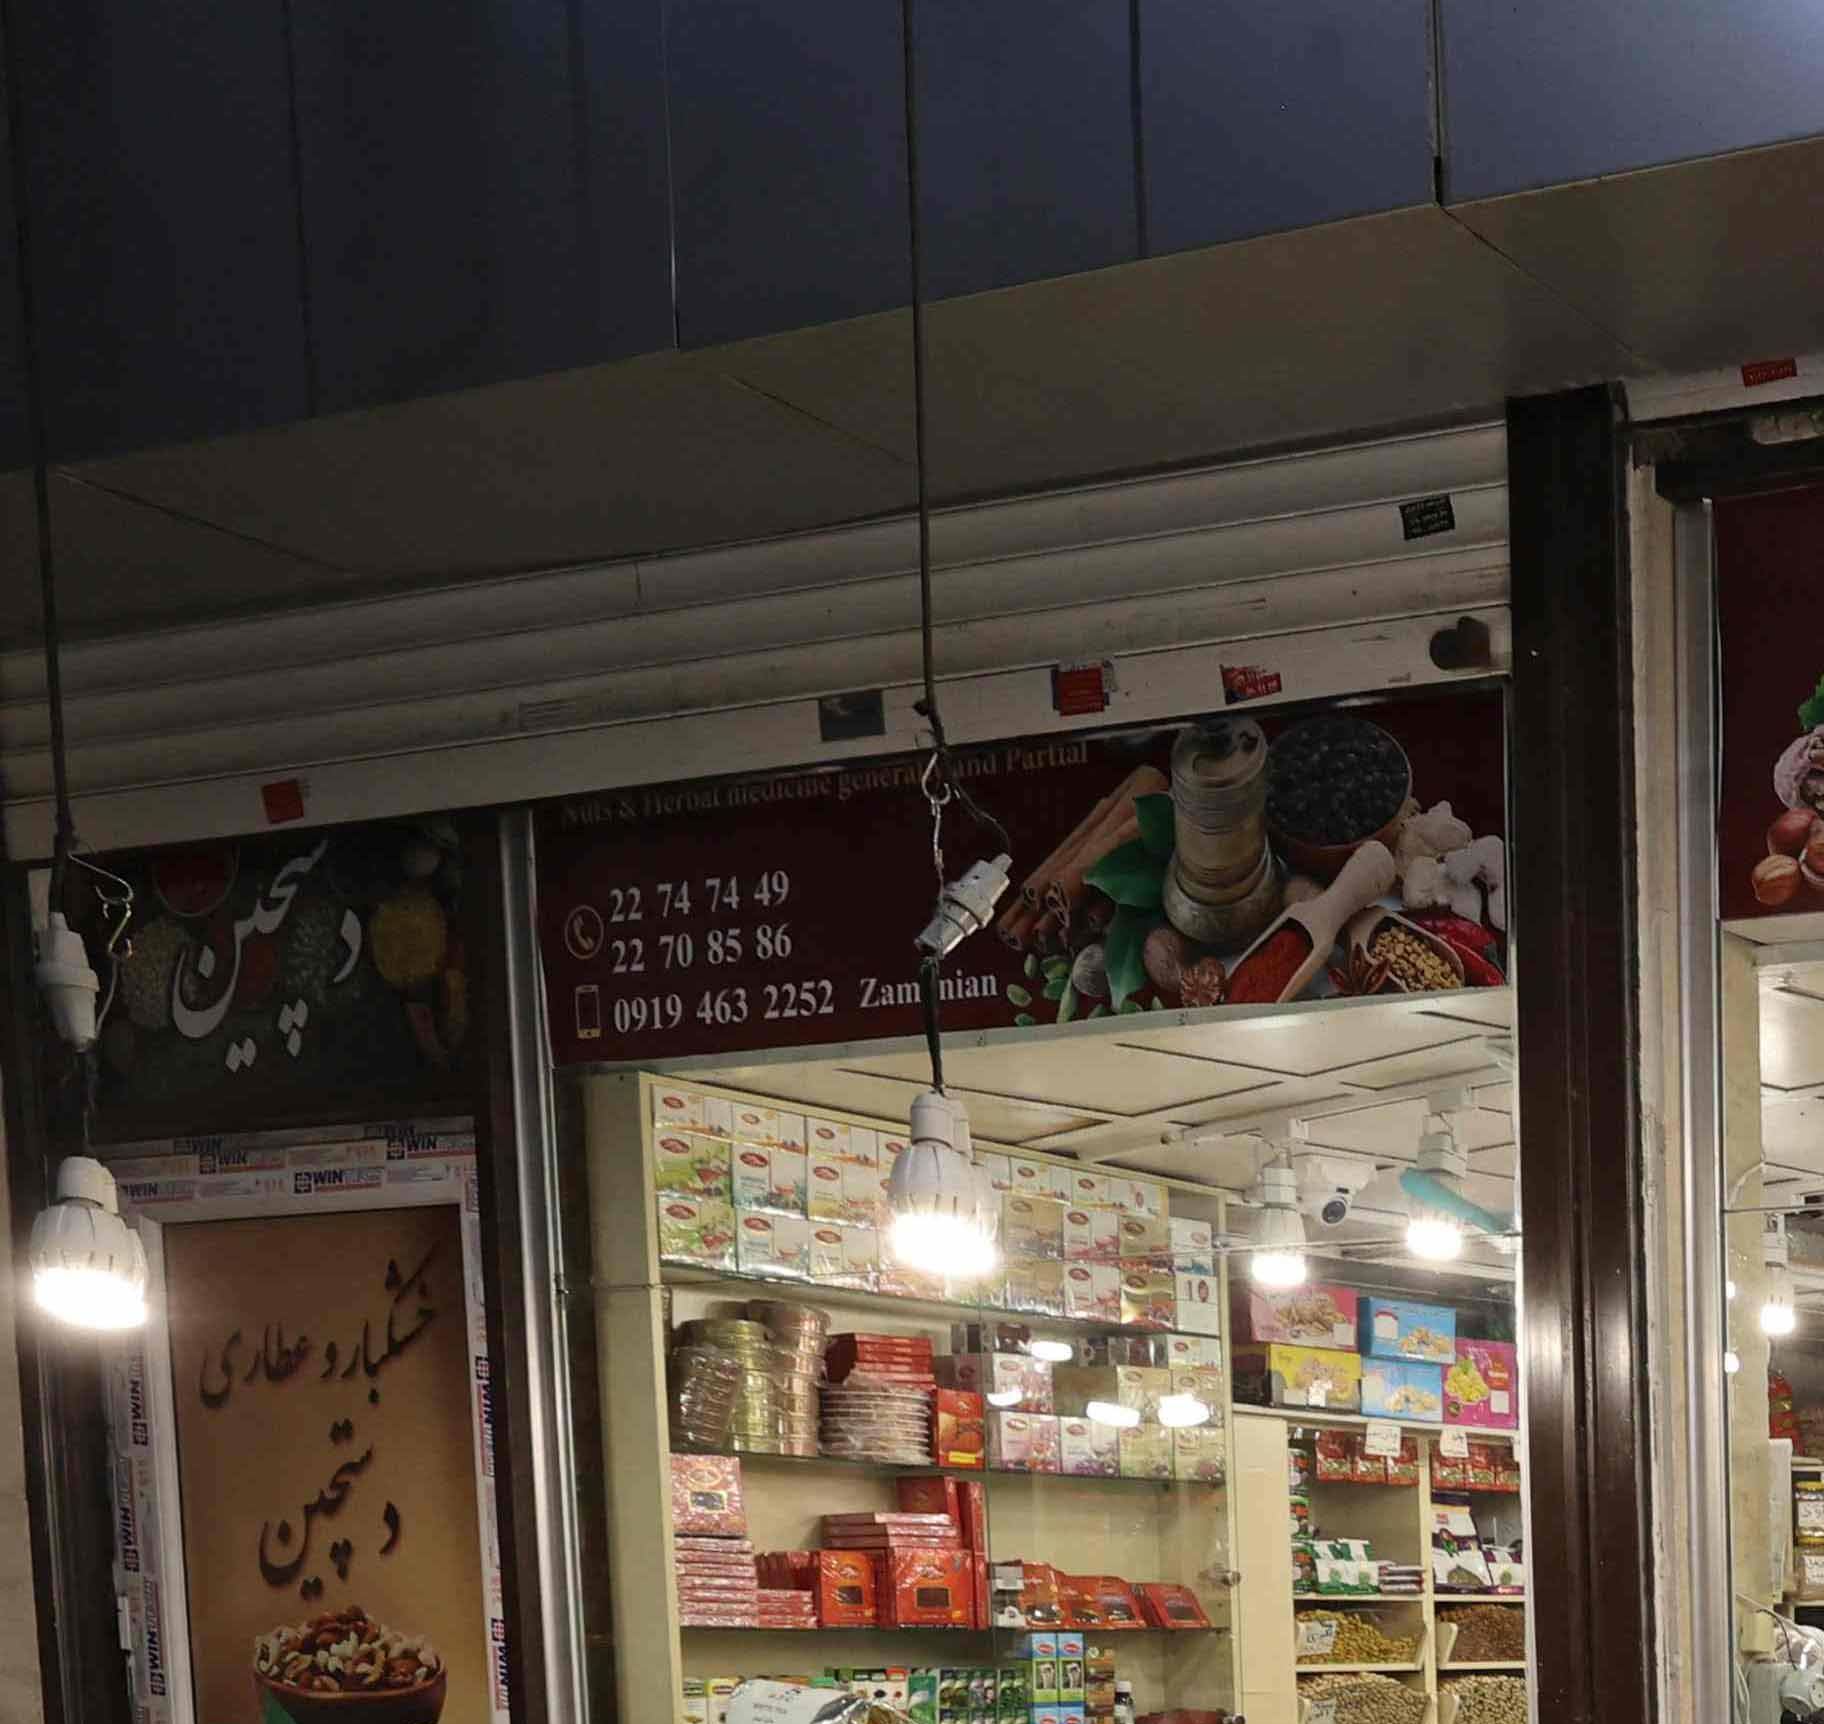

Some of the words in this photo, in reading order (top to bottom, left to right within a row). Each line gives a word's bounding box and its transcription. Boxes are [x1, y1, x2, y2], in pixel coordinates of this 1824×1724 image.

[1006, 742, 1089, 772] Partial
[609, 887, 643, 923] 22
[657, 879, 691, 916] 74
[705, 876, 740, 912] 74
[753, 869, 790, 906] 49
[610, 938, 646, 974] 22
[657, 932, 693, 968] 70
[706, 927, 742, 964] 85
[755, 922, 793, 959] 86
[613, 992, 683, 1034] 0919
[696, 986, 749, 1024] 463
[762, 978, 835, 1020] 2252
[859, 969, 998, 1010] Zamnian
